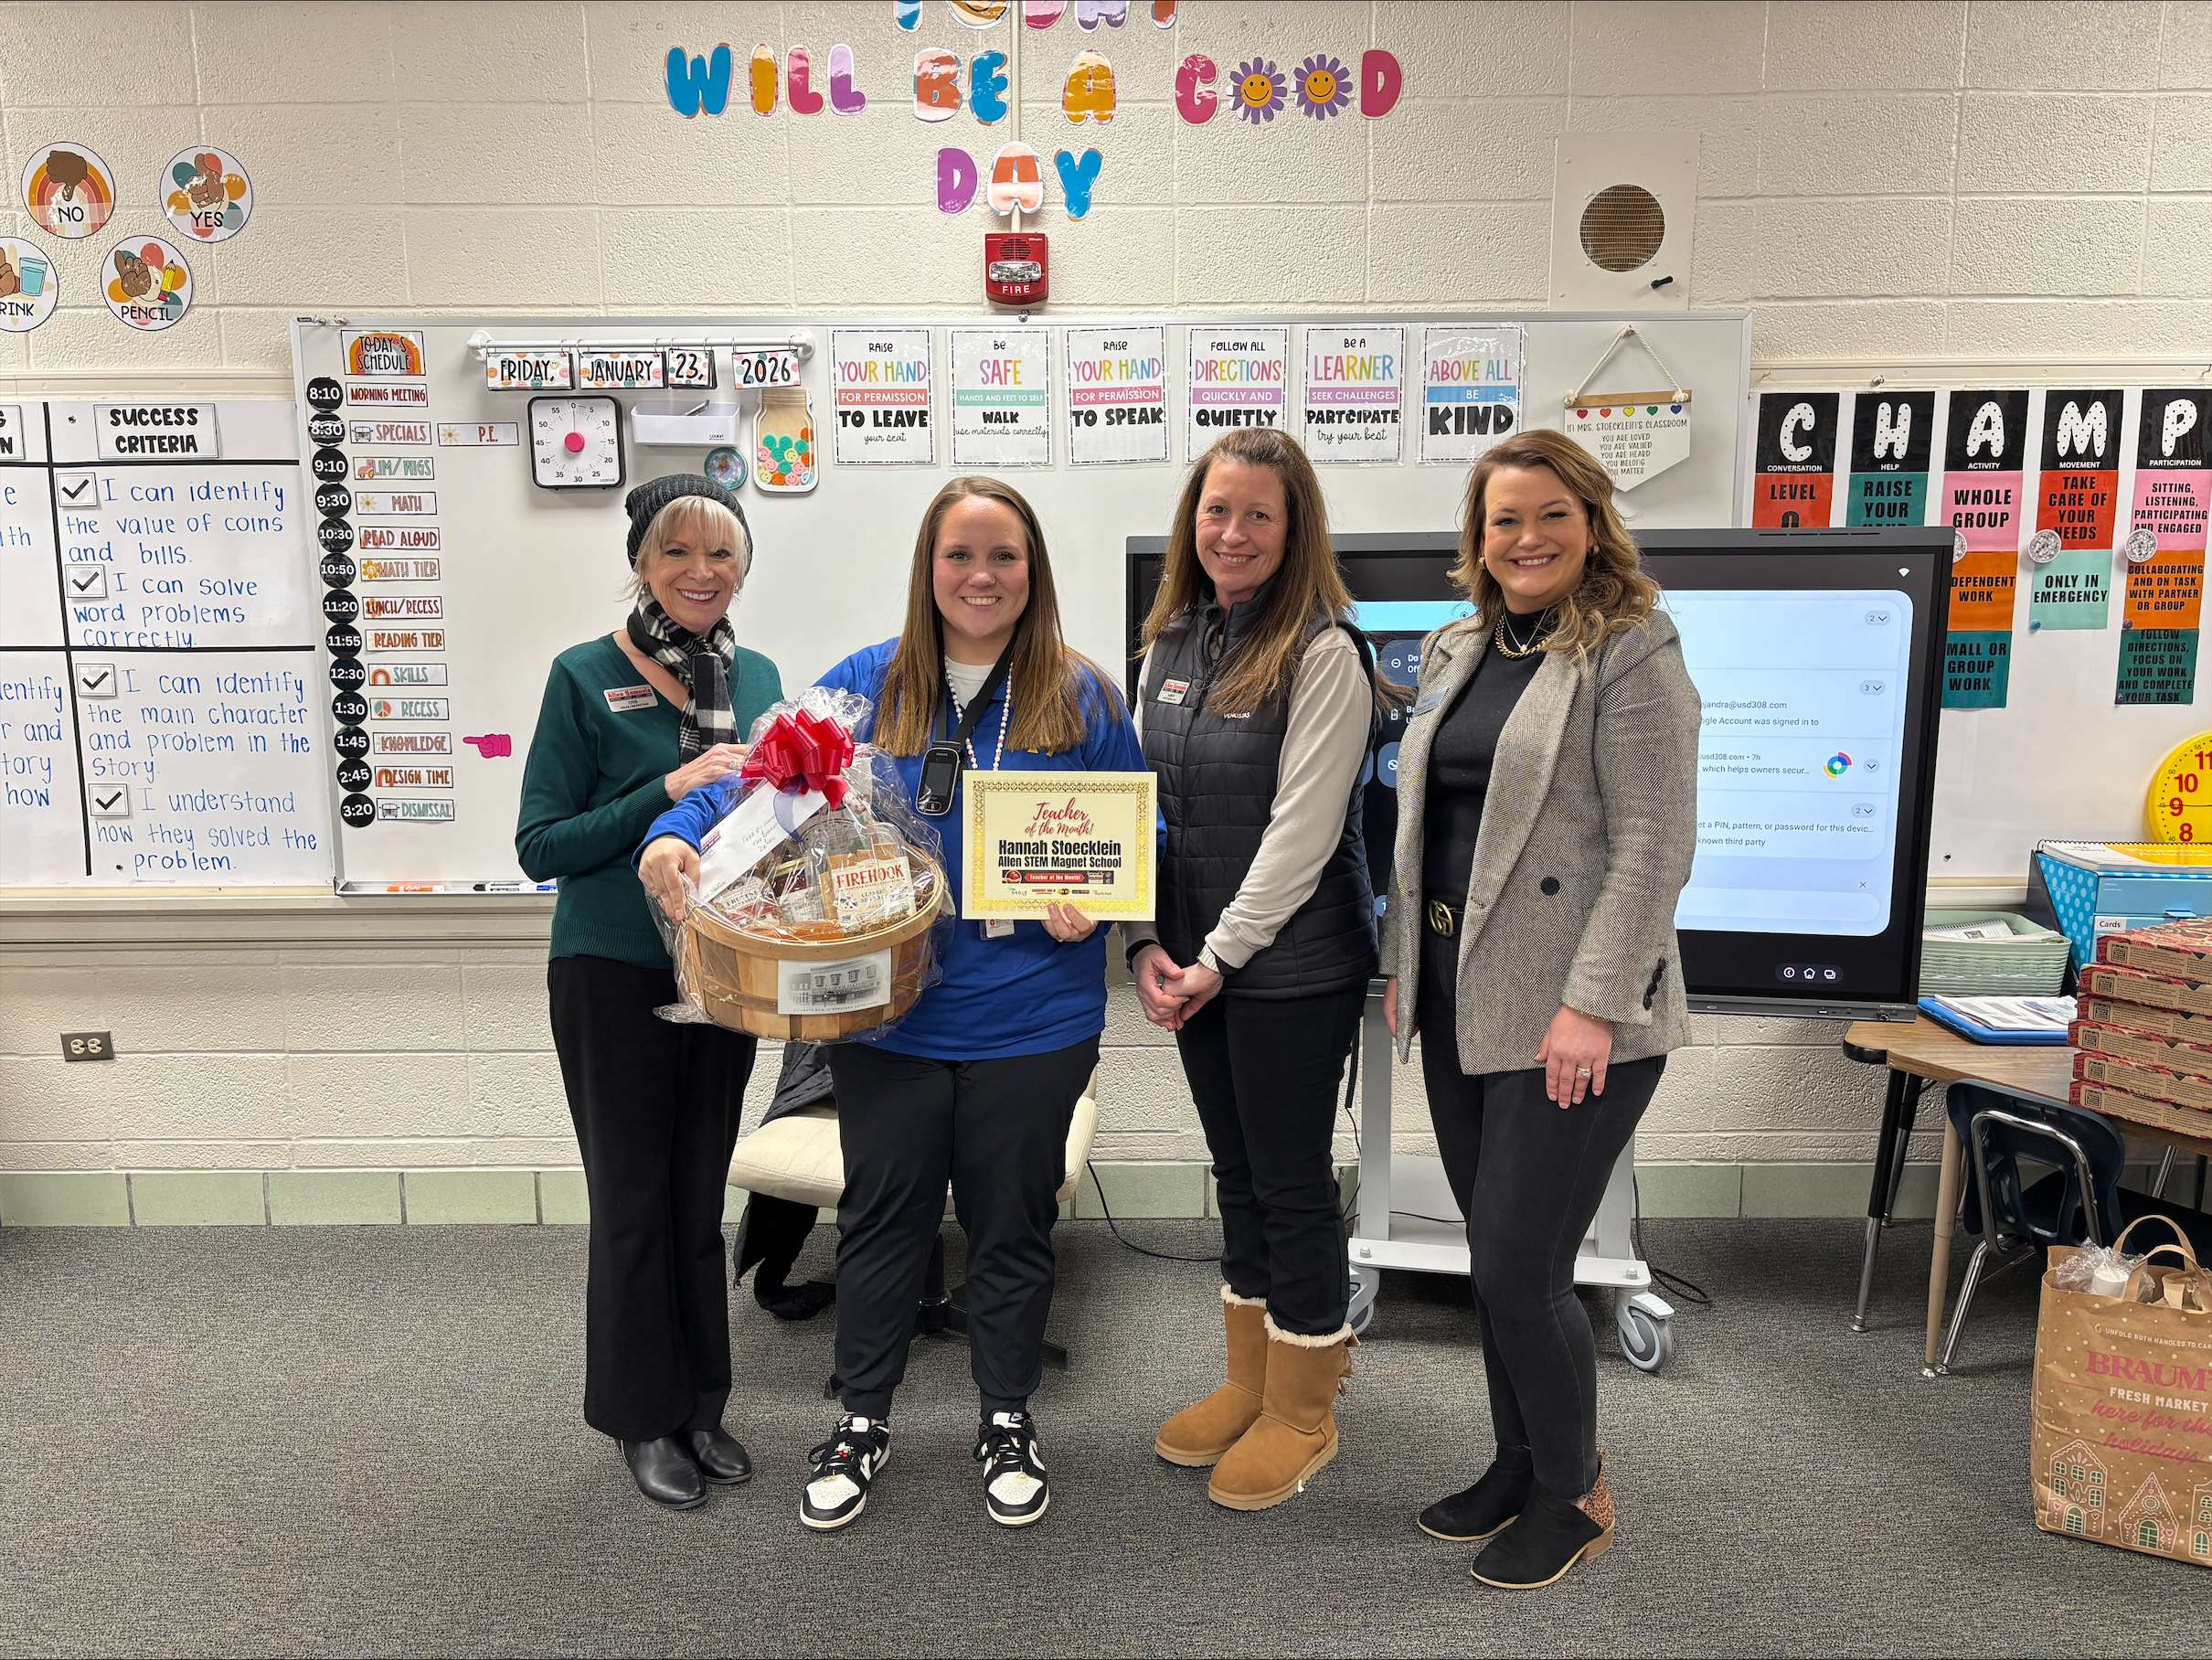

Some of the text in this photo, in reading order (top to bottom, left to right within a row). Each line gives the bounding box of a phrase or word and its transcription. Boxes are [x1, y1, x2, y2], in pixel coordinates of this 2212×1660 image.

[665, 43, 1116, 126] WILL BE A
[935, 142, 1104, 221] DAY
[58, 207, 84, 223] NO
[190, 212, 223, 228] YES
[1003, 285, 1030, 293] FIRE
[121, 306, 173, 321] PENCIL
[357, 354, 410, 370] SCHEDULE
[501, 354, 791, 384] FRIDAY, JANUARY 23, 2026
[1313, 354, 1394, 380] LEARNER
[839, 360, 927, 382] YOUR HAND
[980, 360, 1022, 386] SAFE
[1196, 359, 1281, 382] DIRECTIONS
[1430, 359, 1512, 382] ABOVE ALL
[309, 388, 425, 401] 8:10 MORNING MEETING
[841, 392, 925, 402] FOR PERMISSION
[1202, 391, 1271, 402] QUICKLY AND
[1312, 391, 1395, 400] SEEK CHALLENGES
[1466, 390, 1479, 399] BE
[110, 409, 198, 426] SUCCESS
[839, 410, 928, 428] TO LEAVE
[983, 412, 1019, 424] WALK
[1196, 410, 1277, 428] QUIETLY
[1307, 410, 1399, 424] PARTCIPATE
[1430, 405, 1514, 435] KIND
[1645, 420, 1686, 430] CLASSROOM
[376, 424, 426, 442] SPECIALS
[972, 426, 1047, 439] materials correctly
[1317, 429, 1388, 442] try your best
[1780, 402, 1815, 462] C
[1874, 402, 1911, 459] H
[2057, 400, 2107, 456] M
[2162, 399, 2197, 456] P
[115, 435, 198, 453] CRITERIA
[864, 432, 906, 444] your seat
[314, 460, 346, 473] 9:10
[1864, 481, 1912, 496] RAISE
[2062, 476, 2095, 489] TAKE
[131, 481, 284, 512] can identify
[1771, 484, 1815, 500] LEVEL
[1954, 489, 2011, 505] WHOLE
[2049, 494, 2106, 506] CARE OF
[317, 495, 421, 511] 9:30 MATH
[2145, 496, 2197, 506] LISTENING,
[1866, 503, 1908, 517] YOUR
[2058, 510, 2095, 523] YOUR
[2134, 510, 2207, 520] PARTICIPATING
[66, 514, 283, 535] the value of coins
[1952, 512, 2009, 528] GROUP
[2158, 524, 2201, 533] ENGAGED
[320, 529, 437, 547] 10:30 READ ALOUD
[69, 542, 113, 562] and
[2129, 565, 2203, 574] COLLABORATING
[2046, 575, 2099, 588] ONLY IN
[2034, 591, 2108, 603] EMERGENCY
[2158, 590, 2198, 598] PARTNER
[74, 603, 245, 626] word problems
[324, 601, 357, 612] 11:20
[327, 633, 442, 648] 11:55 READING TIER
[331, 667, 428, 683] 12:30 SKILLS
[2143, 680, 2193, 689] COMPLETE
[335, 700, 439, 717] 1:30 RECESS
[1773, 718, 1799, 726] signed
[337, 735, 447, 751] 1:45 KNOWLEDGE
[339, 769, 450, 785] 2:45 DESIGN TIME
[1728, 766, 1749, 775] helps
[2175, 773, 2198, 793] 10
[169, 790, 294, 813] understand
[1033, 797, 1089, 821] Teacher
[2170, 797, 2183, 816] 9
[343, 802, 452, 818] 3:20 DISMISSAL
[1025, 820, 1093, 837] of the Month!
[1732, 823, 1813, 832] pattern, password
[2180, 823, 2193, 842] 8
[96, 822, 317, 851] how they solved the
[1725, 837, 1766, 847] third party
[999, 840, 1121, 855] Hannah Stoecklein
[999, 857, 1121, 868] Allen STEM Magnet School
[836, 865, 904, 888] FIREHOOK
[2106, 1328, 2185, 1346] UNFOLD BOTH HANDLES
[2110, 1387, 2208, 1412] FRESH MARKET
[2091, 1399, 2179, 1431] here for
[2105, 1433, 2202, 1462] holidays
